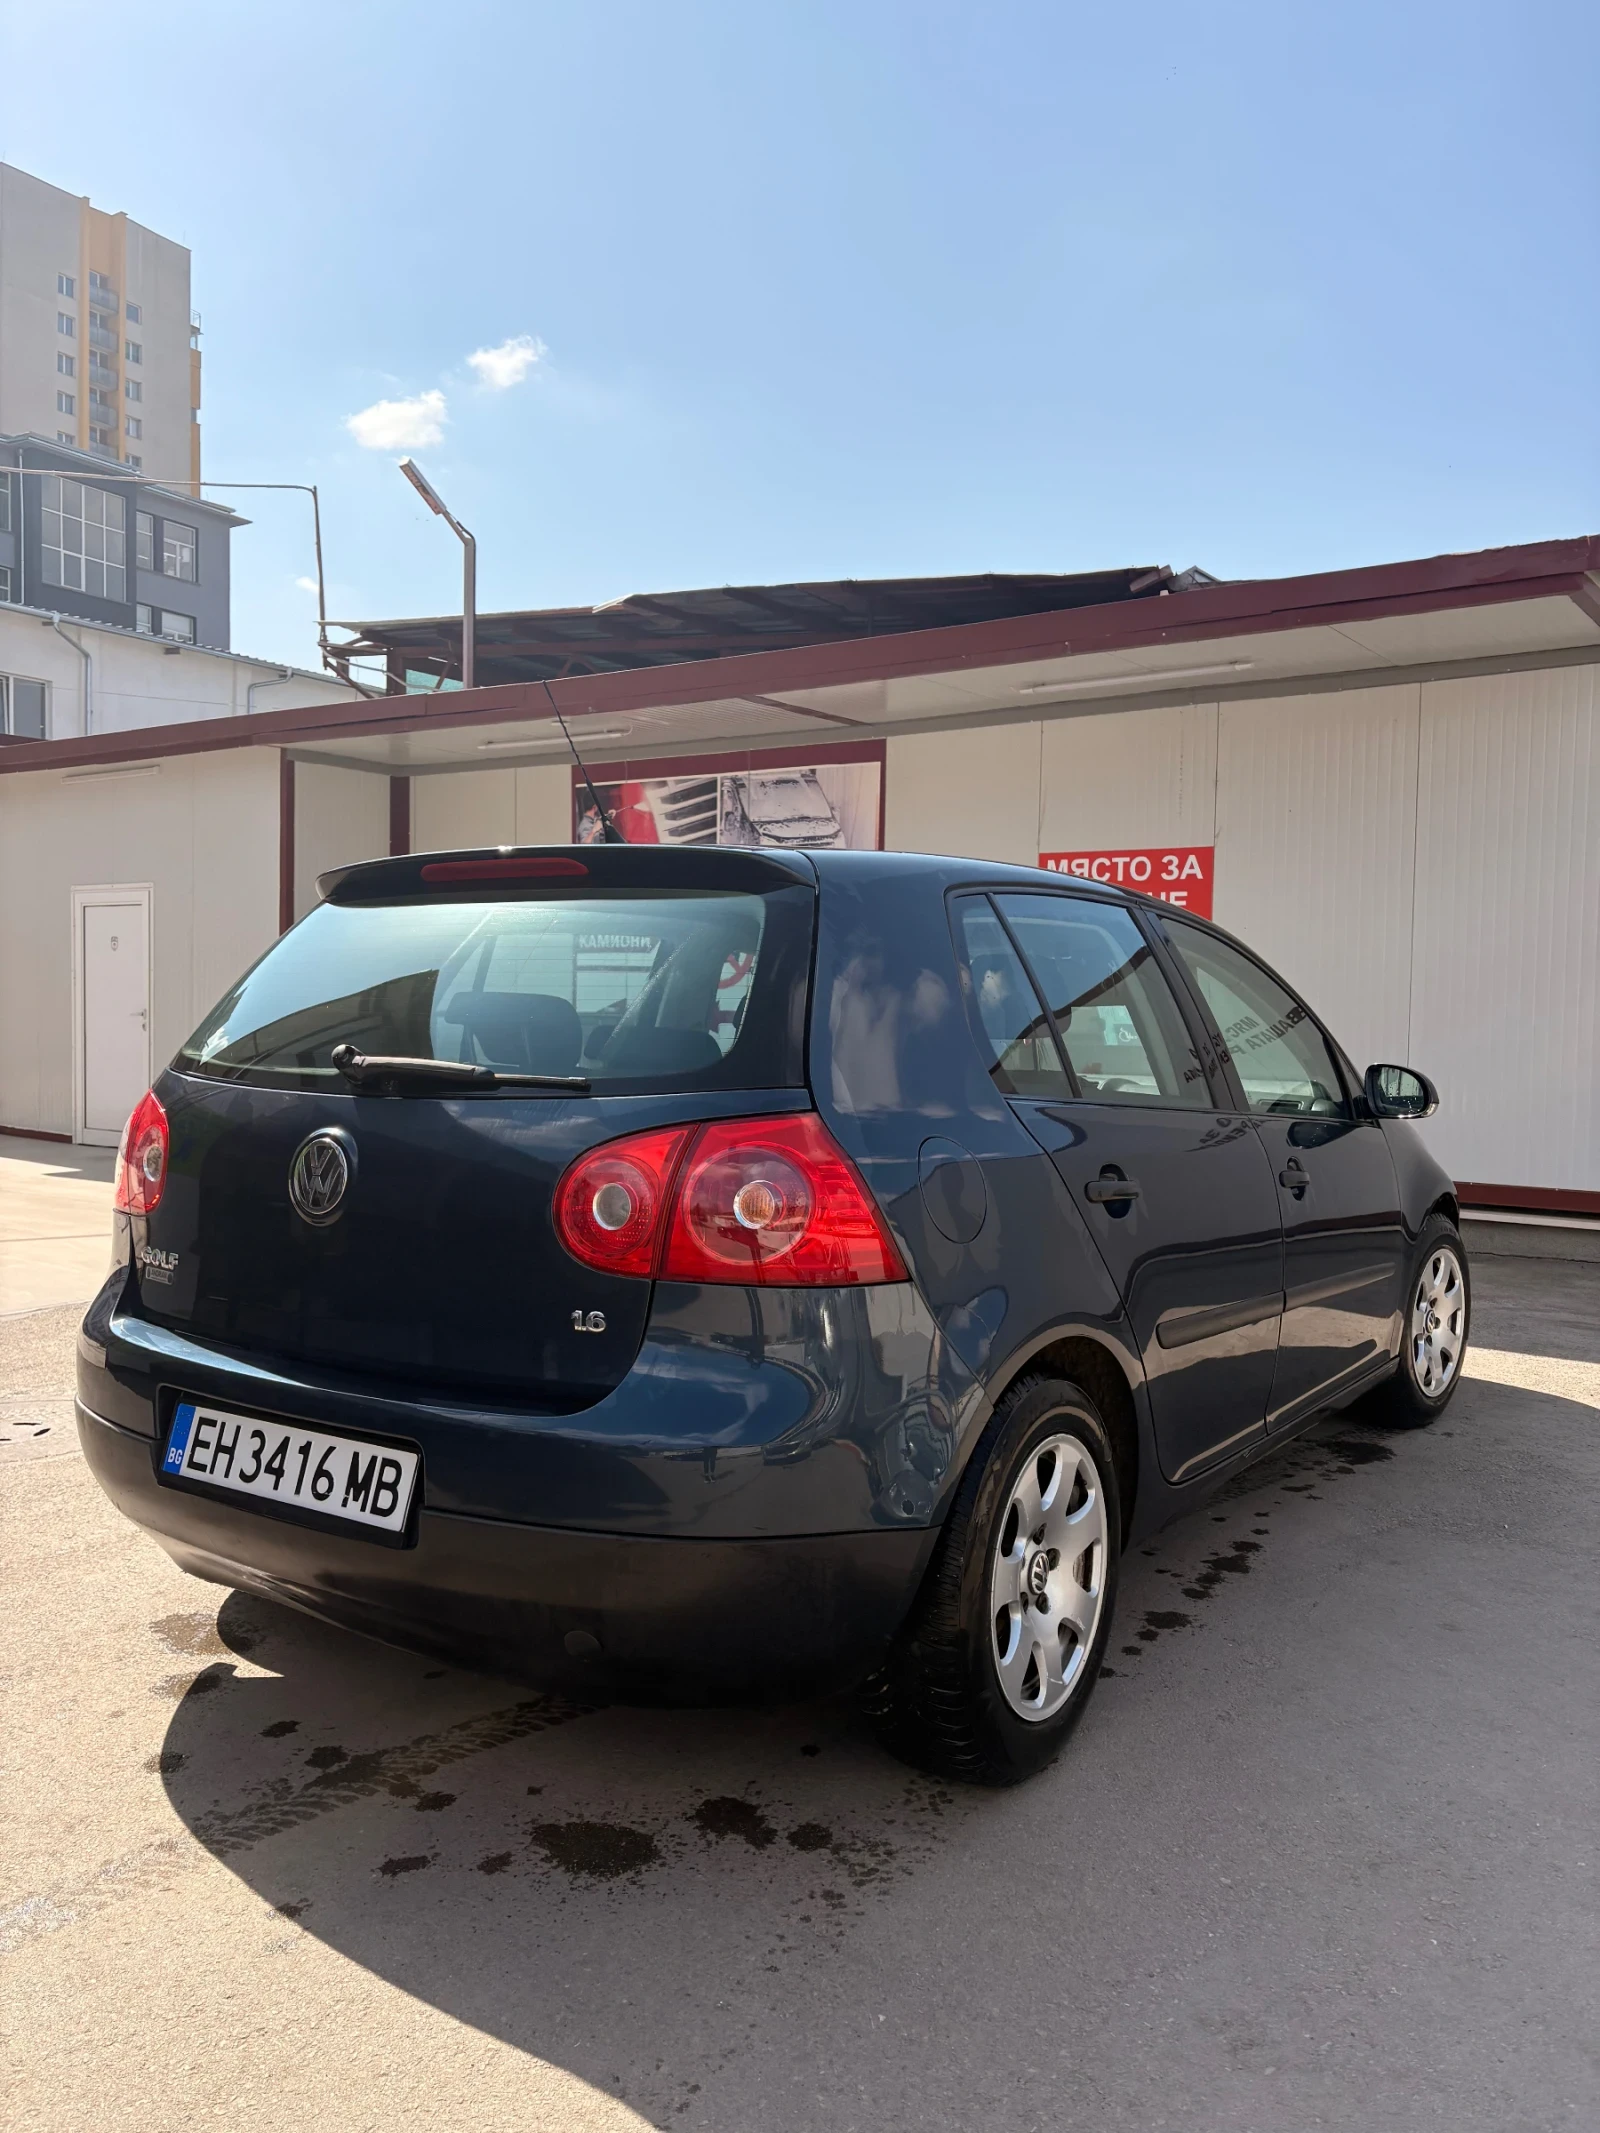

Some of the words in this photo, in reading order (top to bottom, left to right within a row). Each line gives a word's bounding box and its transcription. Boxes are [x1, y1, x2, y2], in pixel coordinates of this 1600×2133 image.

[1161, 855, 1203, 880] ЗА
[141, 1246, 179, 1270] GOLF
[570, 1309, 606, 1333] 1.6
[167, 1447, 183, 1465] BG
